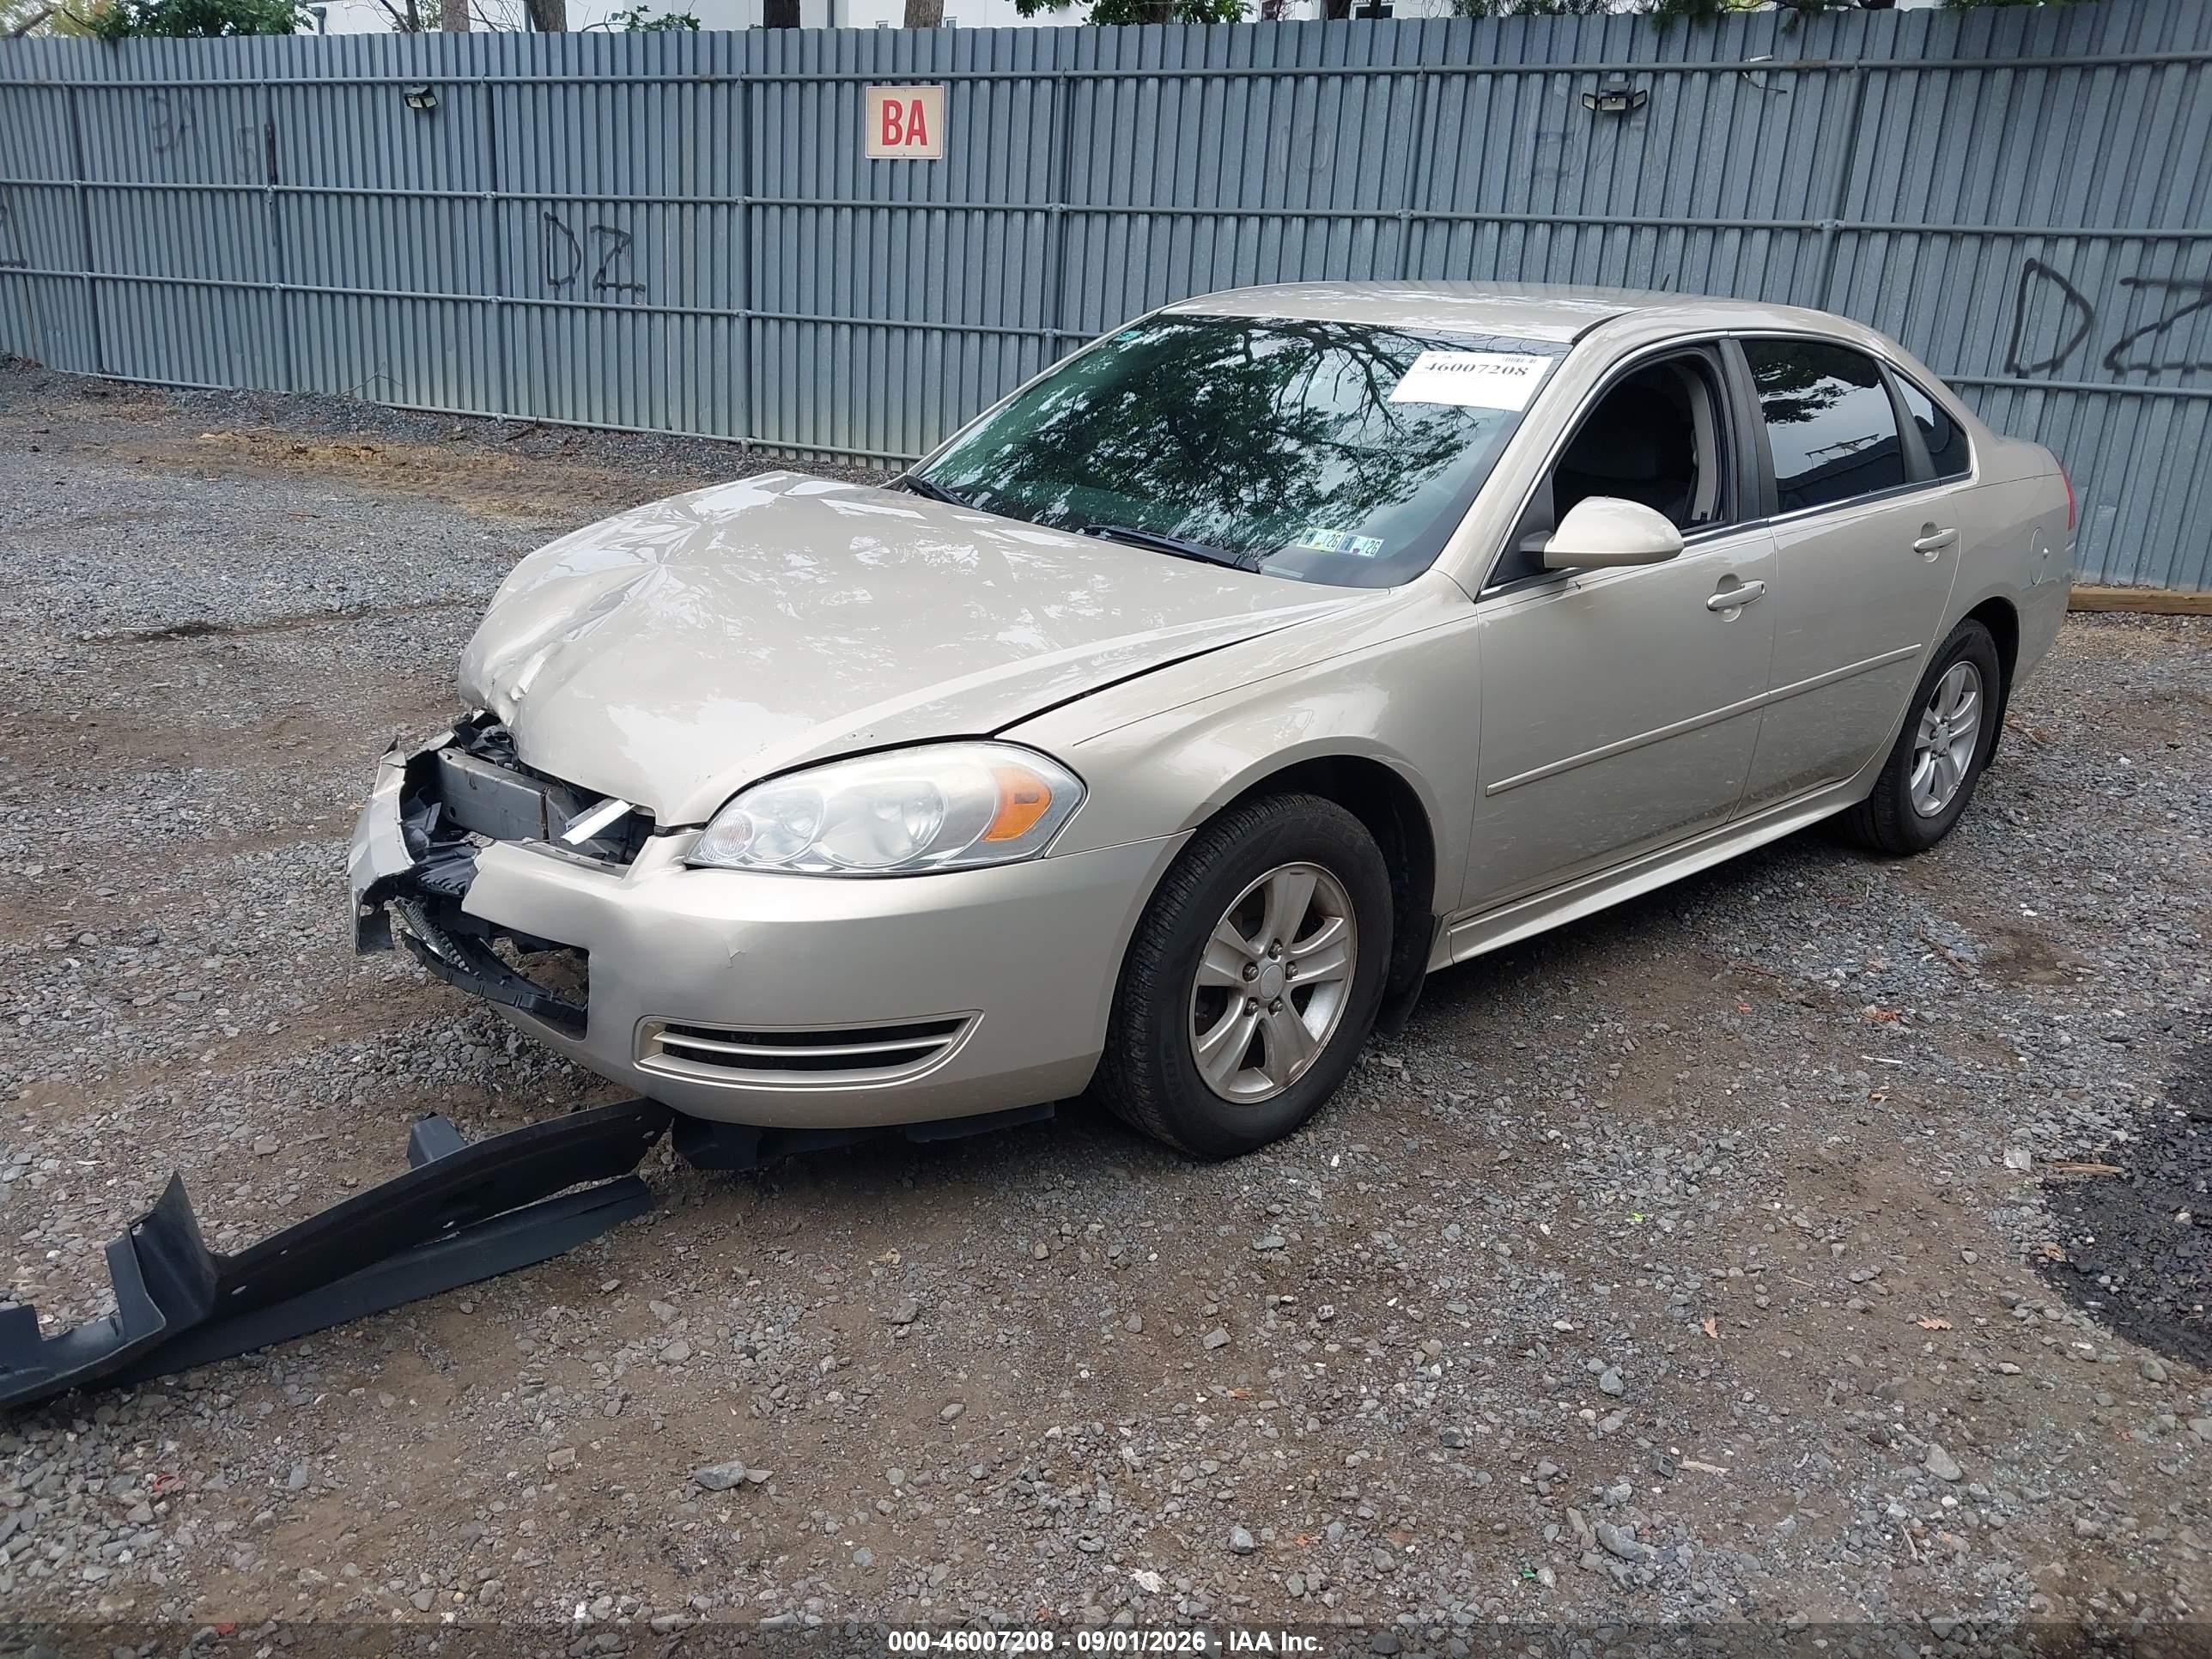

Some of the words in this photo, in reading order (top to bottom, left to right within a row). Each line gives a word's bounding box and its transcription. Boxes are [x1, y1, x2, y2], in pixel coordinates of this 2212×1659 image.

[882, 99, 928, 146] BA
[544, 211, 646, 292] DZ
[1425, 362, 1529, 377] 46007208
